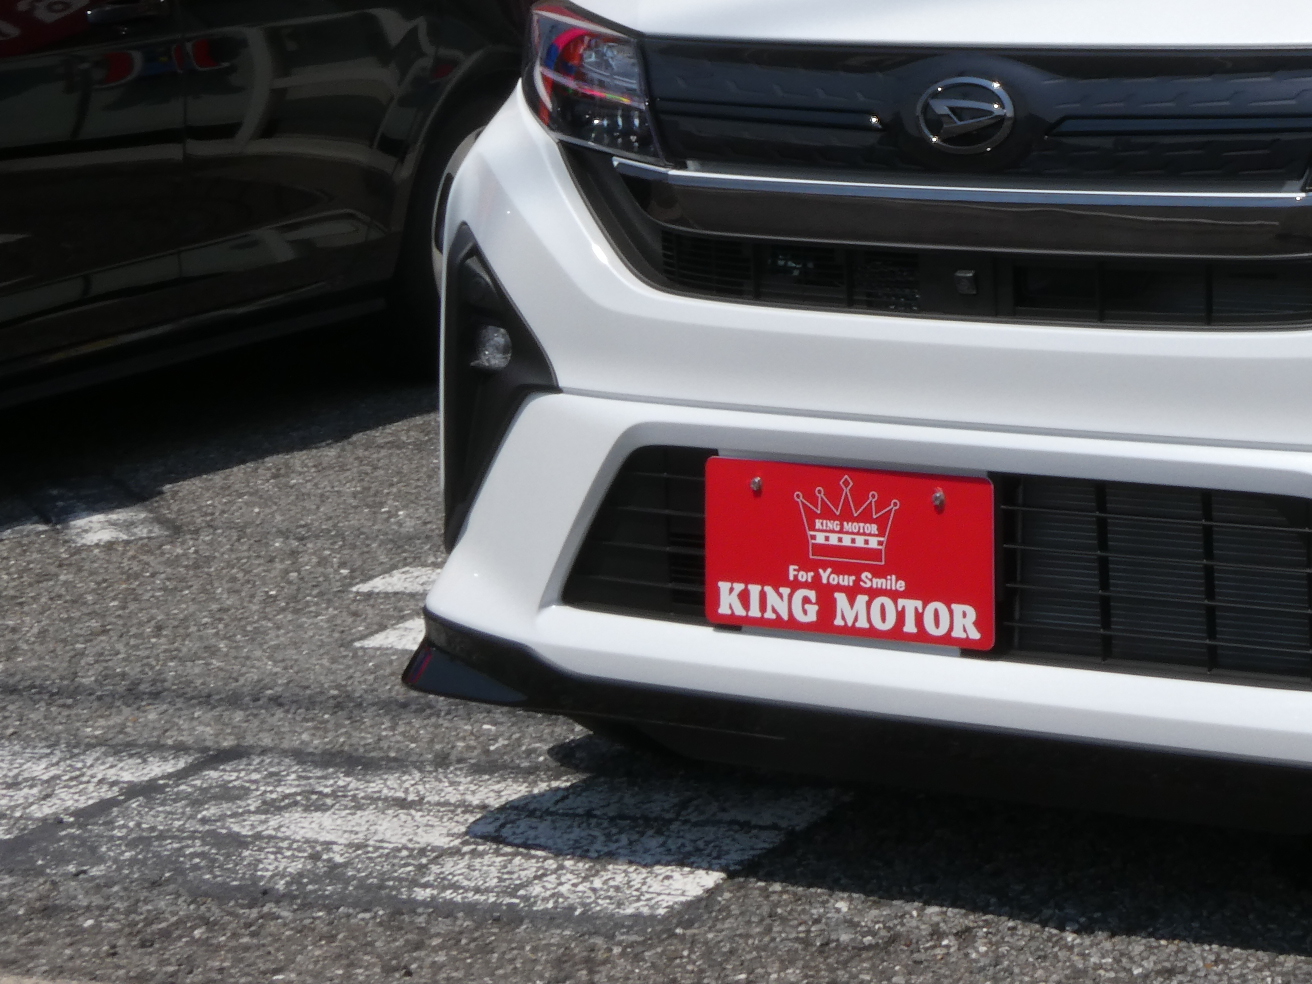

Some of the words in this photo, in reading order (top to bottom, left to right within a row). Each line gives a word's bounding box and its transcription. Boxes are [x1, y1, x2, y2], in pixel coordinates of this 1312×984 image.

[815, 519, 840, 532] KING
[843, 522, 879, 535] MOTOR
[788, 565, 814, 583] For
[819, 568, 856, 587] Your
[859, 572, 906, 592] Smile
[717, 581, 819, 624] KING
[833, 592, 982, 641] MOTOR
